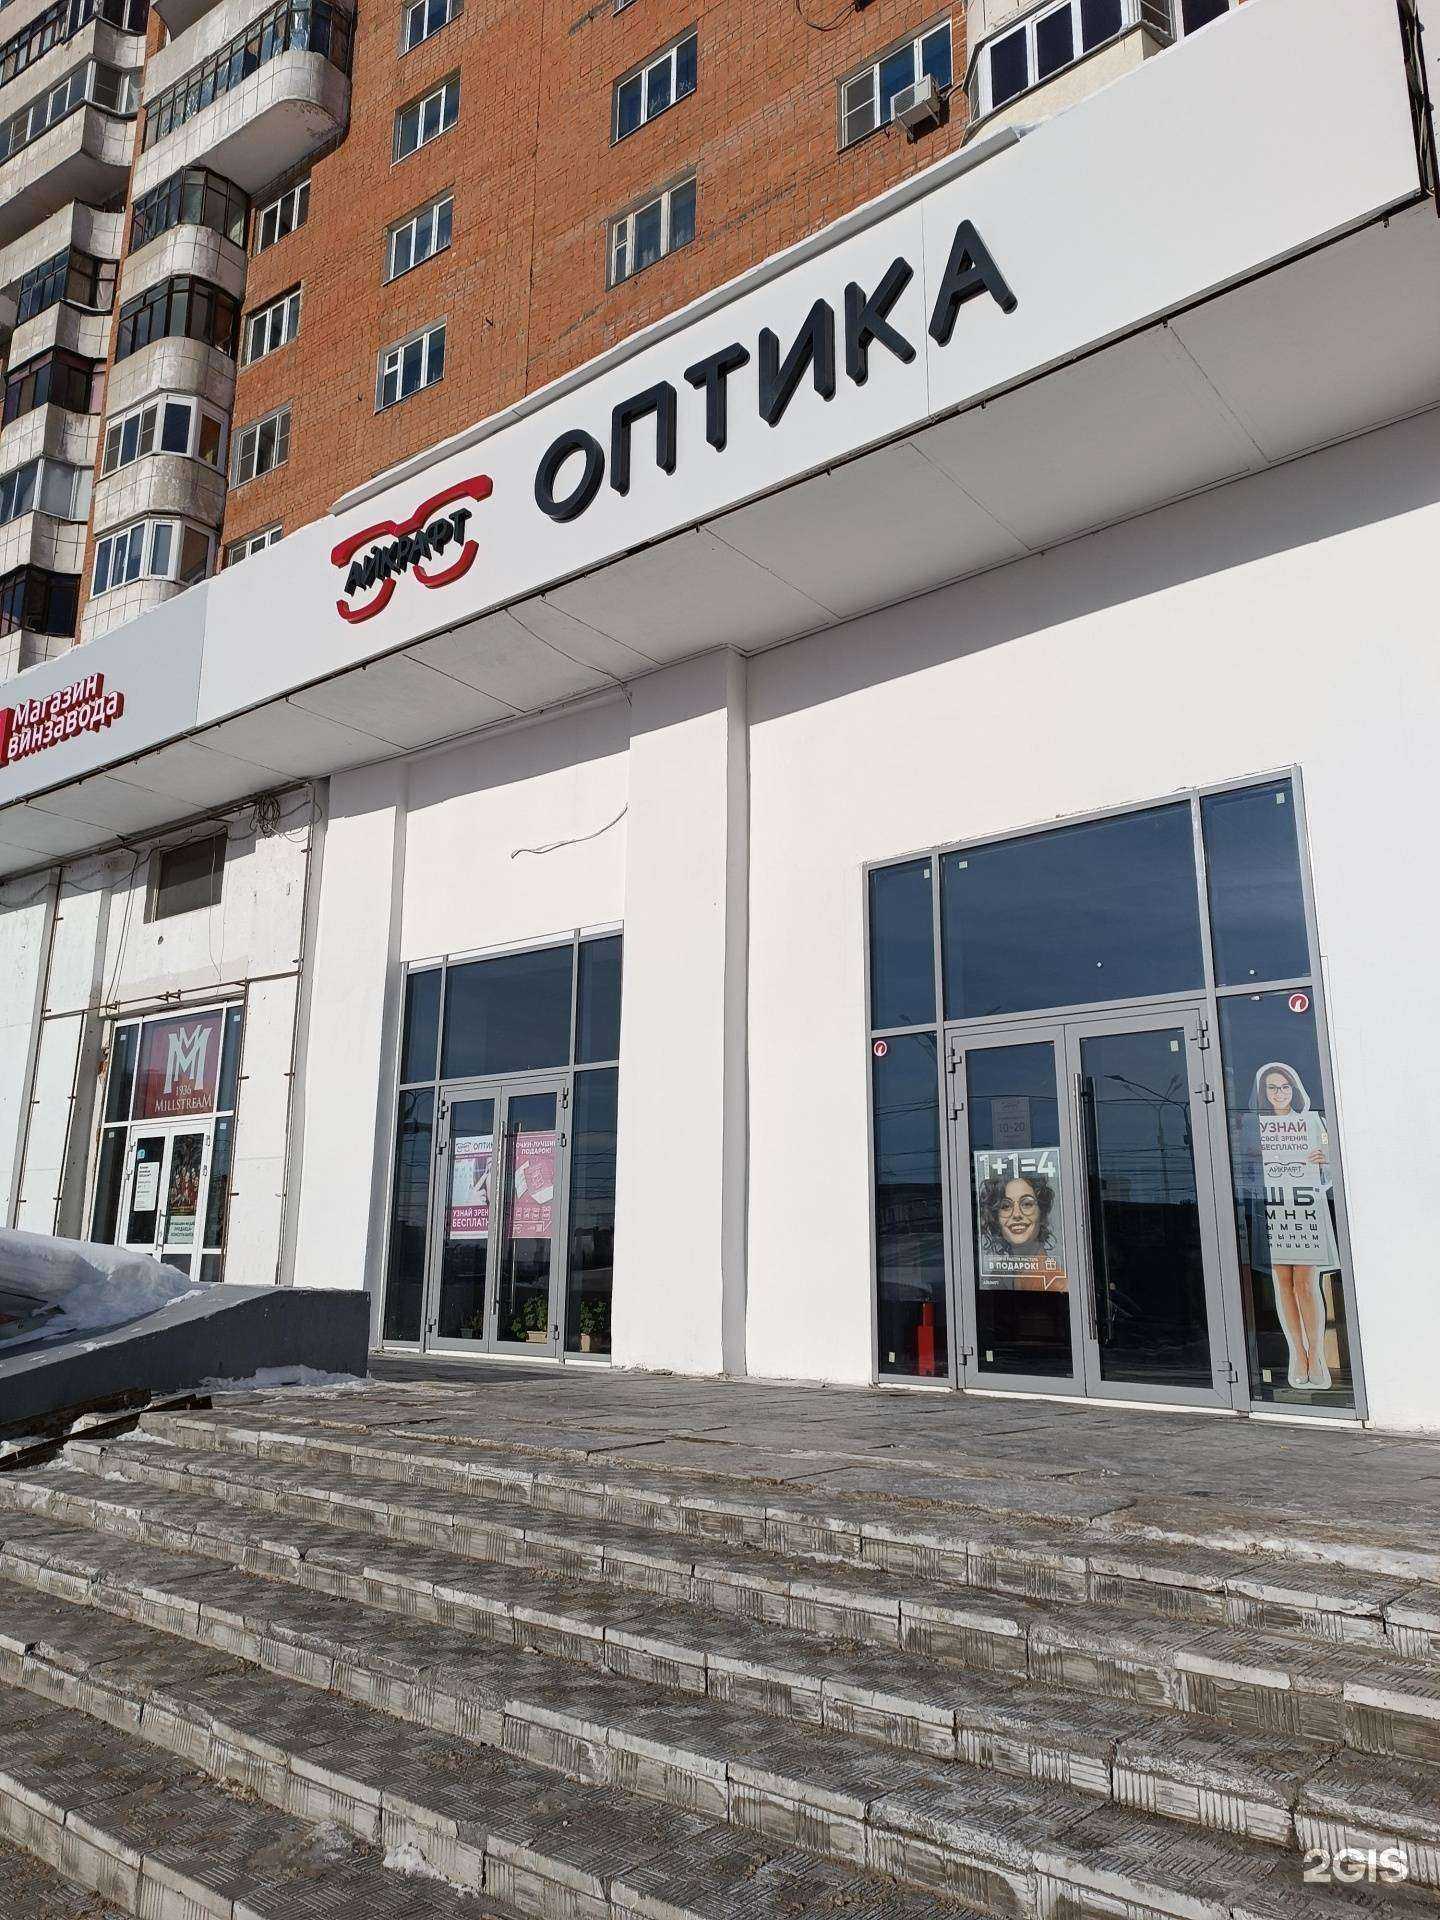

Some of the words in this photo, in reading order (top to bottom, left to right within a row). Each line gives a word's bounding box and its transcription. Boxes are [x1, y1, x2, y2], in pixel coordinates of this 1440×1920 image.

[534, 219, 1018, 523] ОПТИКА
[344, 507, 472, 597] АЙКРАФТ
[11, 672, 104, 731] Магазин
[7, 691, 124, 761] винзавода
[155, 1094, 212, 1113] MILLSTREAM
[1260, 1118, 1307, 1133] УЗНАЙ
[1260, 1143, 1309, 1151] БЕСПЛАТНО
[980, 1151, 1056, 1179] 1+1=4
[989, 1262, 995, 1270] В
[996, 1261, 1039, 1271] ПОДАРОК!
